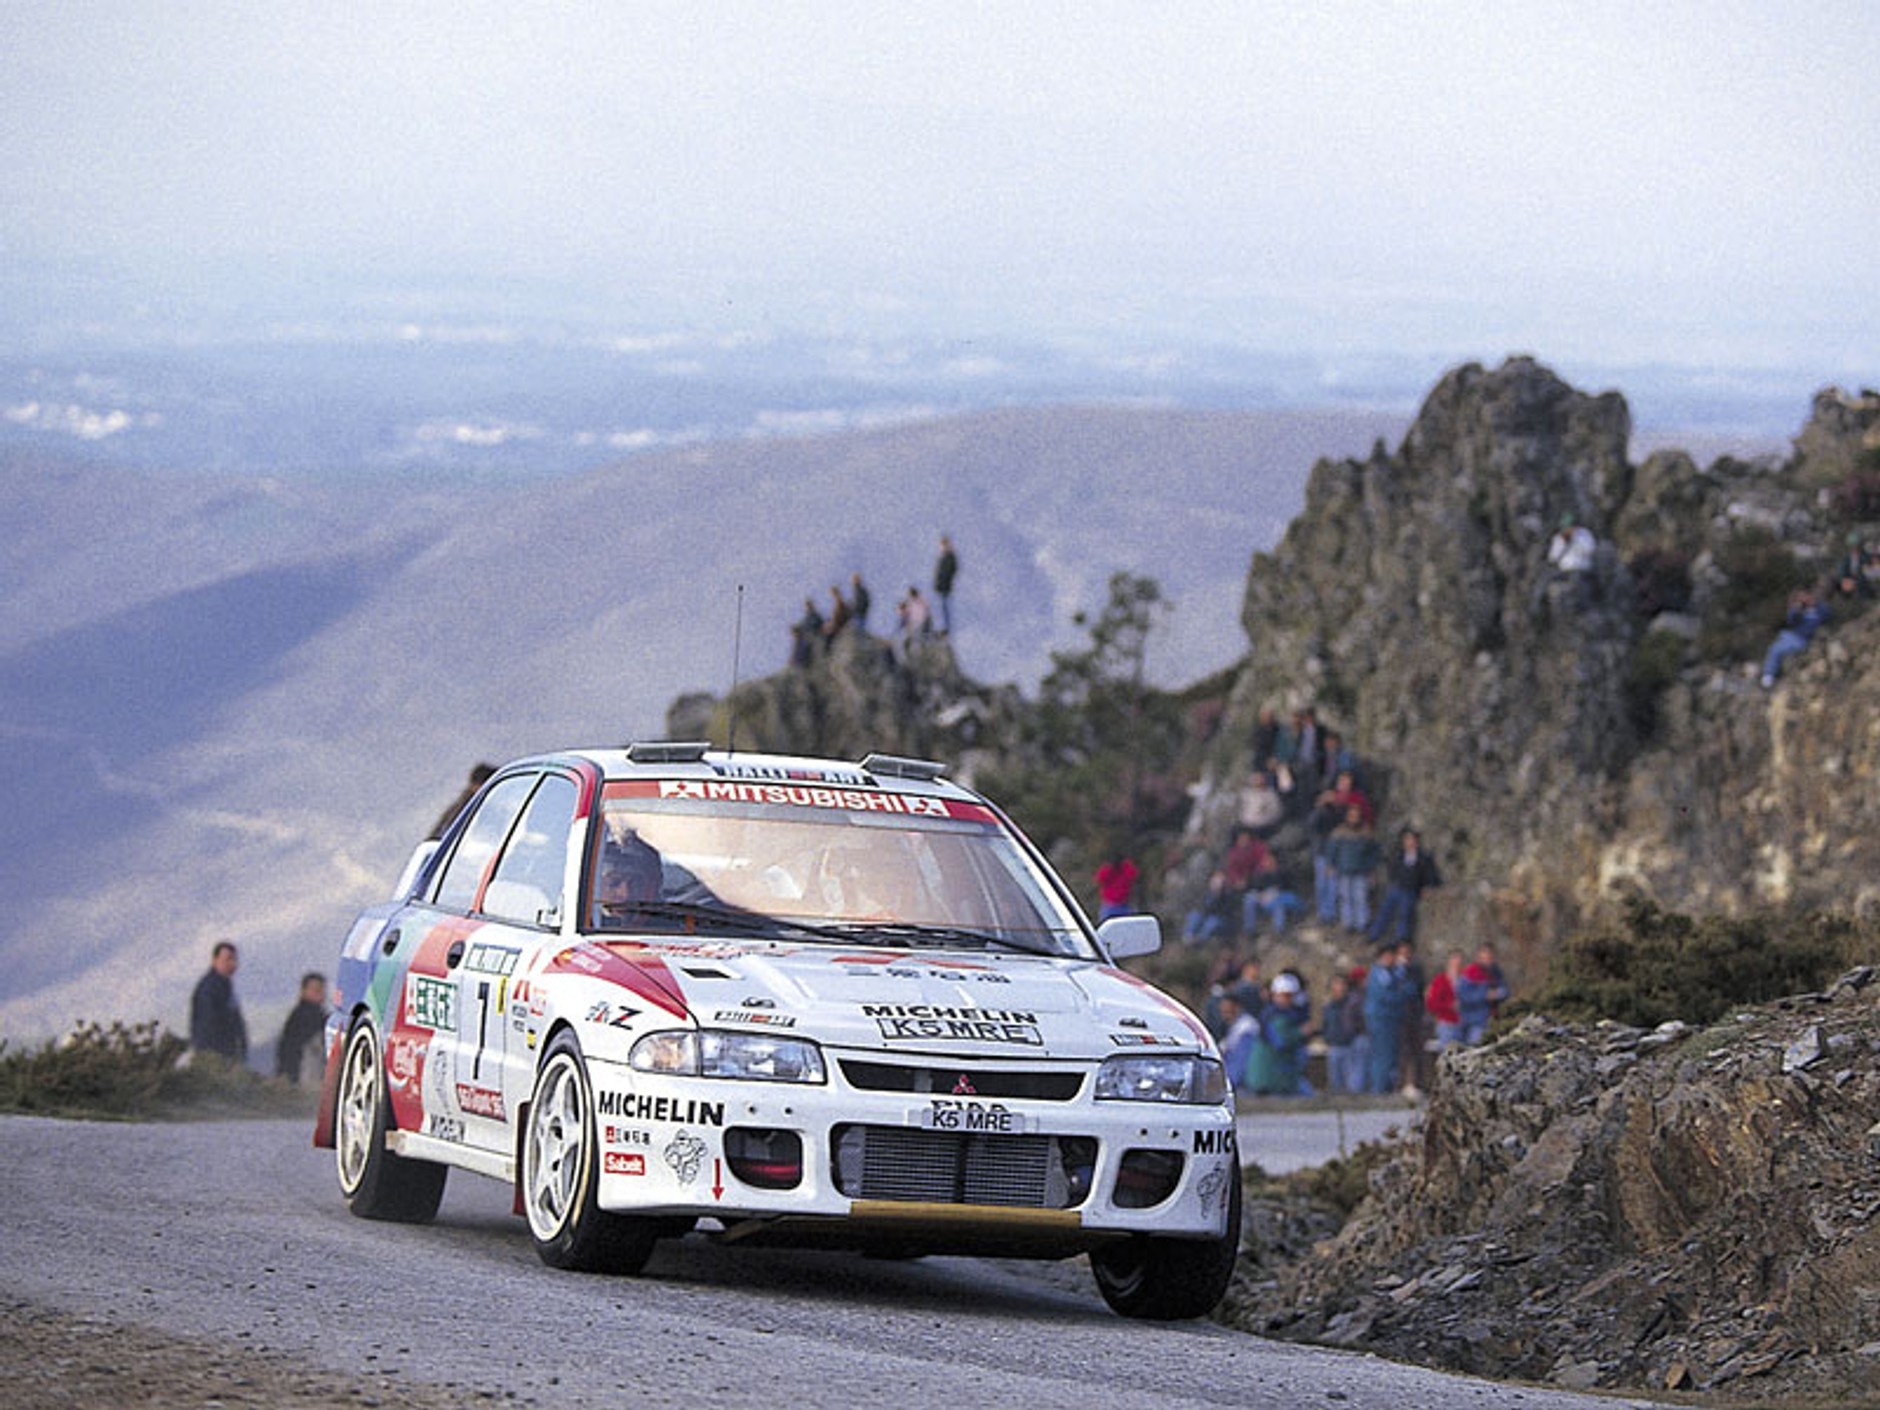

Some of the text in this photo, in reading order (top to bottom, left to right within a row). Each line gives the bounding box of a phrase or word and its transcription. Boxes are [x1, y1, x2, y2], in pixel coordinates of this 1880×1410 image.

[708, 782, 904, 813] MITSUBISHI
[861, 1005, 1038, 1024] MICHELIN
[473, 982, 490, 1080] 1
[893, 1017, 1030, 1044] K5 MRE
[598, 1090, 725, 1127] MICHELIN
[931, 1110, 1012, 1131] K5 MRE
